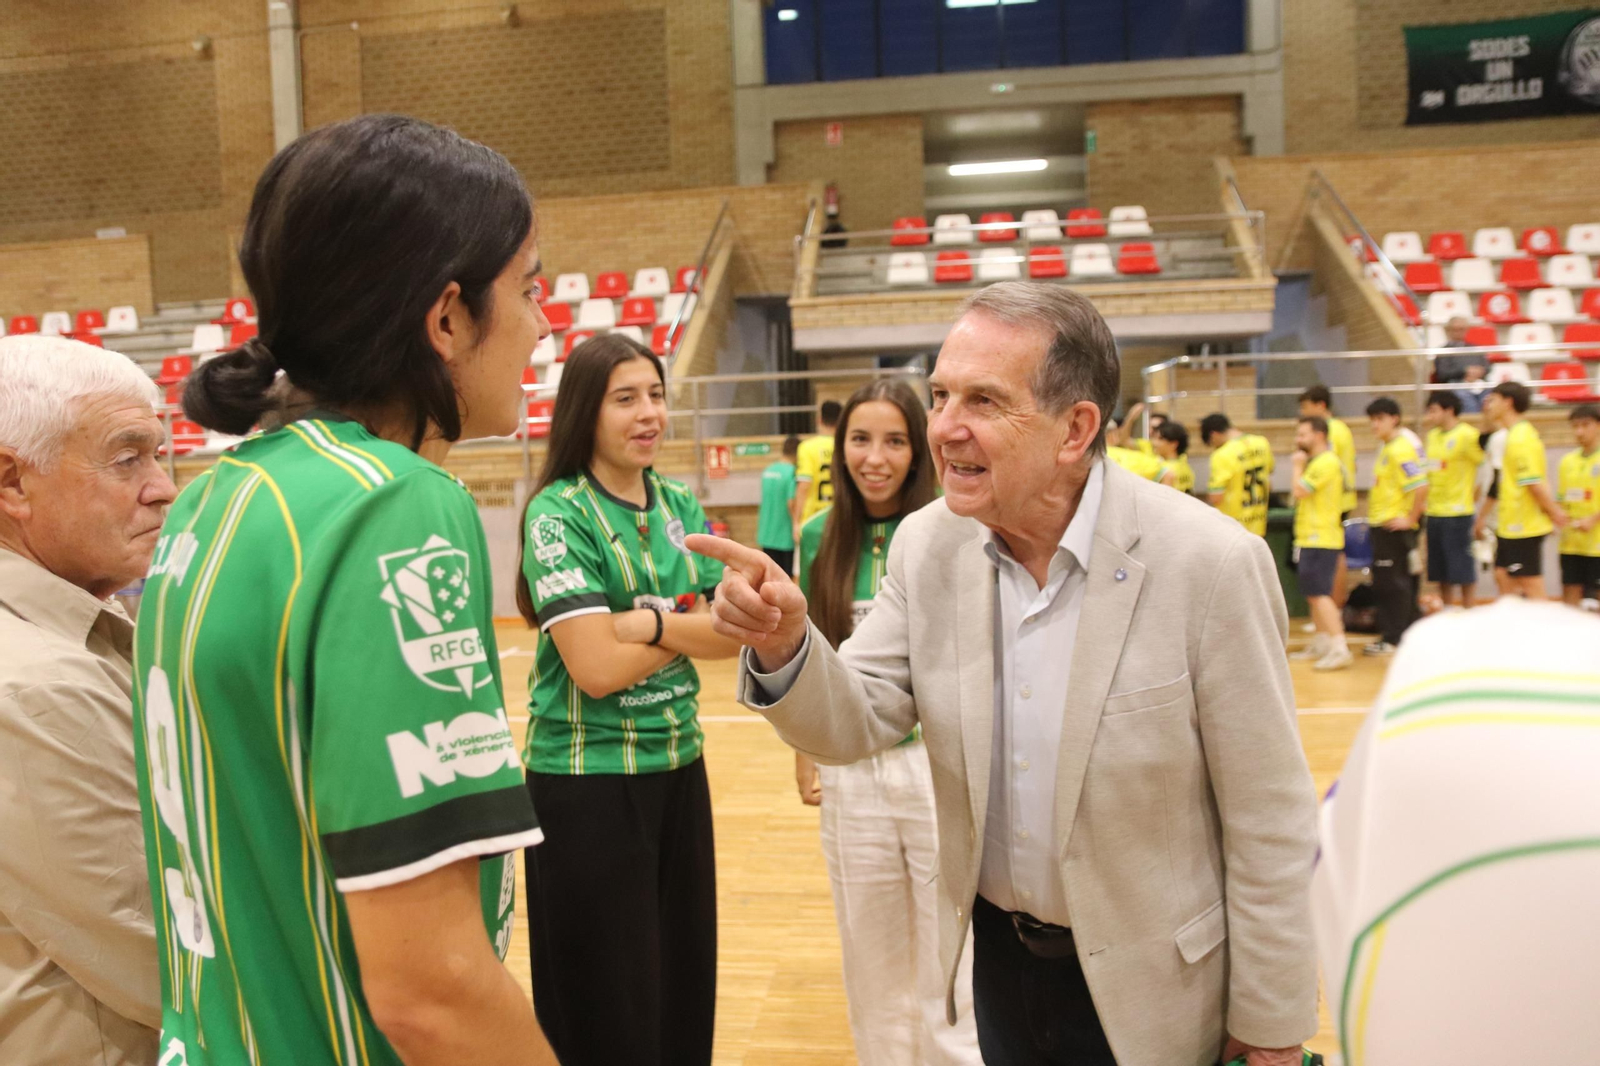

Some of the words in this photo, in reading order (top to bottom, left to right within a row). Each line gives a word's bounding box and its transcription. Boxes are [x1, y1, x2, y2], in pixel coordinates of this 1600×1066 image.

[1455, 78, 1543, 106] ORGULLO
[535, 567, 588, 603] NON
[619, 690, 673, 708] Xacobeo
[439, 750, 457, 764] de
